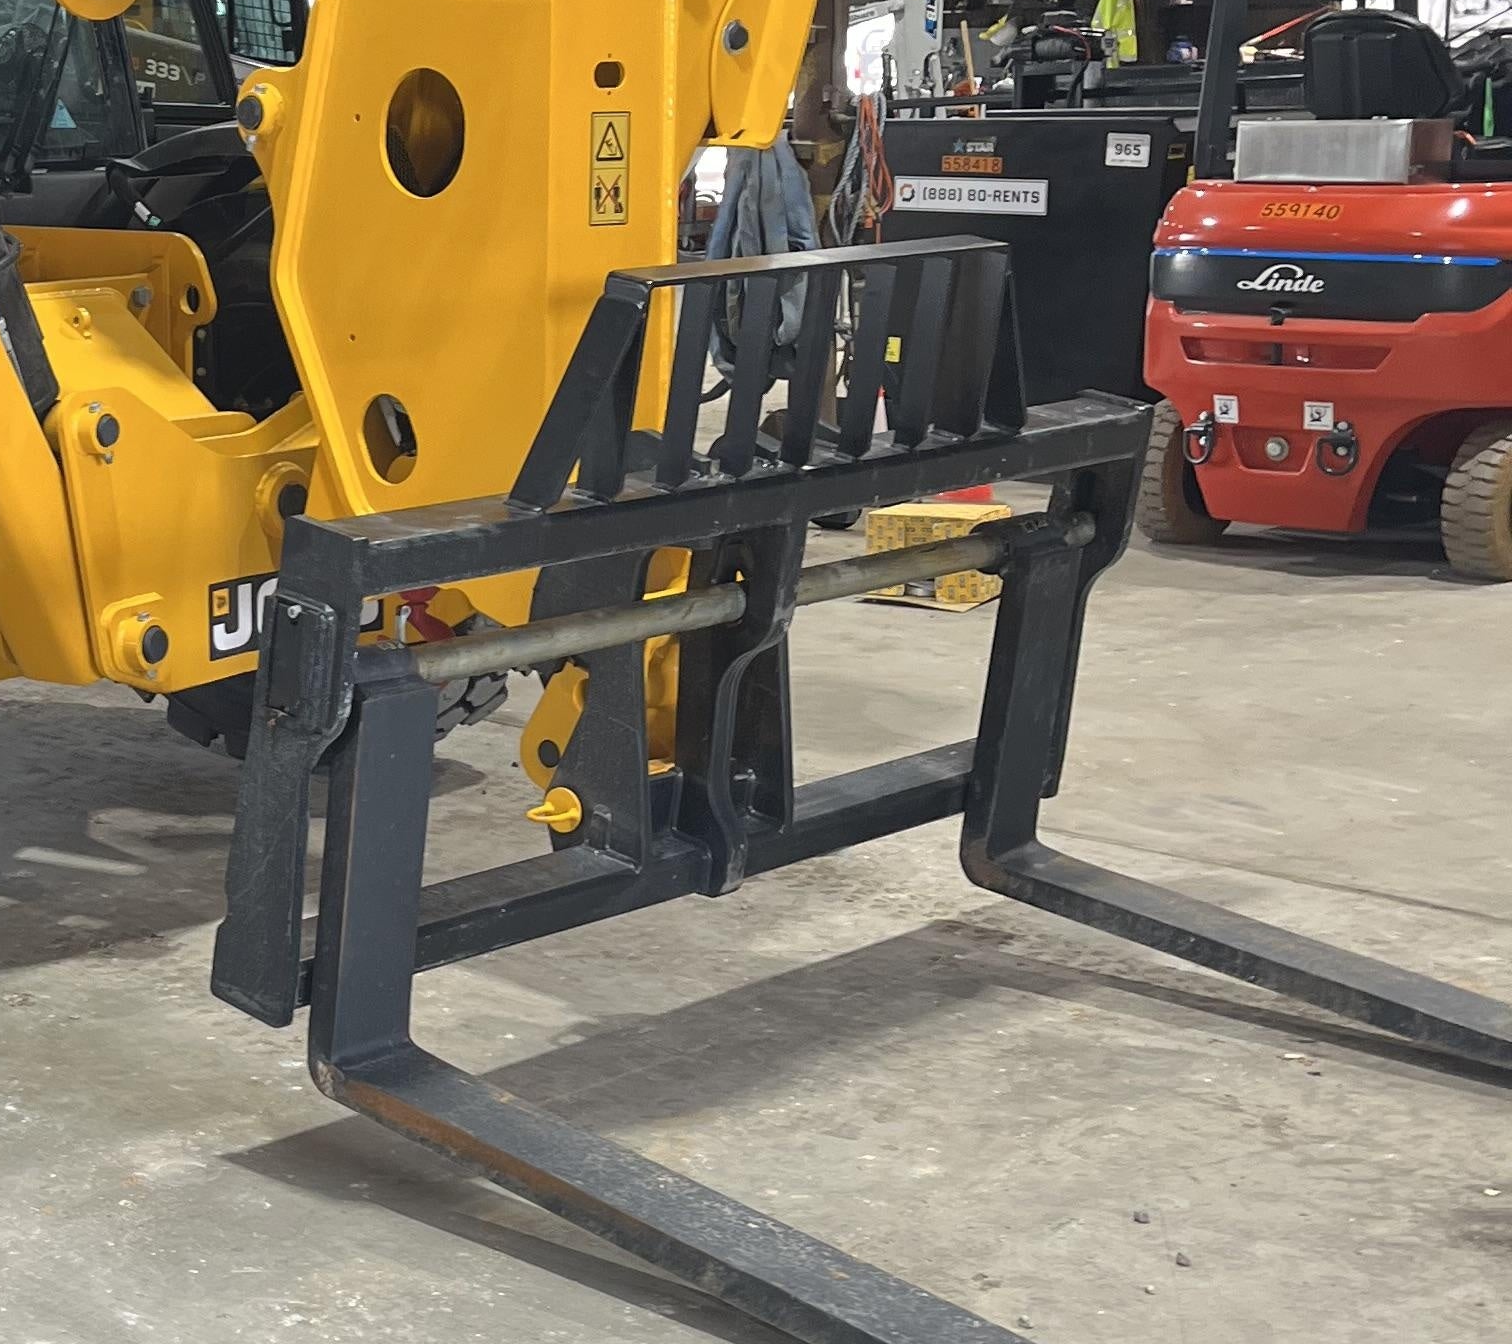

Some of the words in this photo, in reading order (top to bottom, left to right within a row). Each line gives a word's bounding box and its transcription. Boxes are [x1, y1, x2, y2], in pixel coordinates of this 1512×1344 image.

[145, 59, 181, 81] 333
[1114, 144, 1141, 156] 965
[943, 157, 1001, 172] 558418
[967, 189, 1040, 204] 80-RENTS
[1261, 203, 1340, 219] 559140
[1236, 263, 1325, 293] Linde
